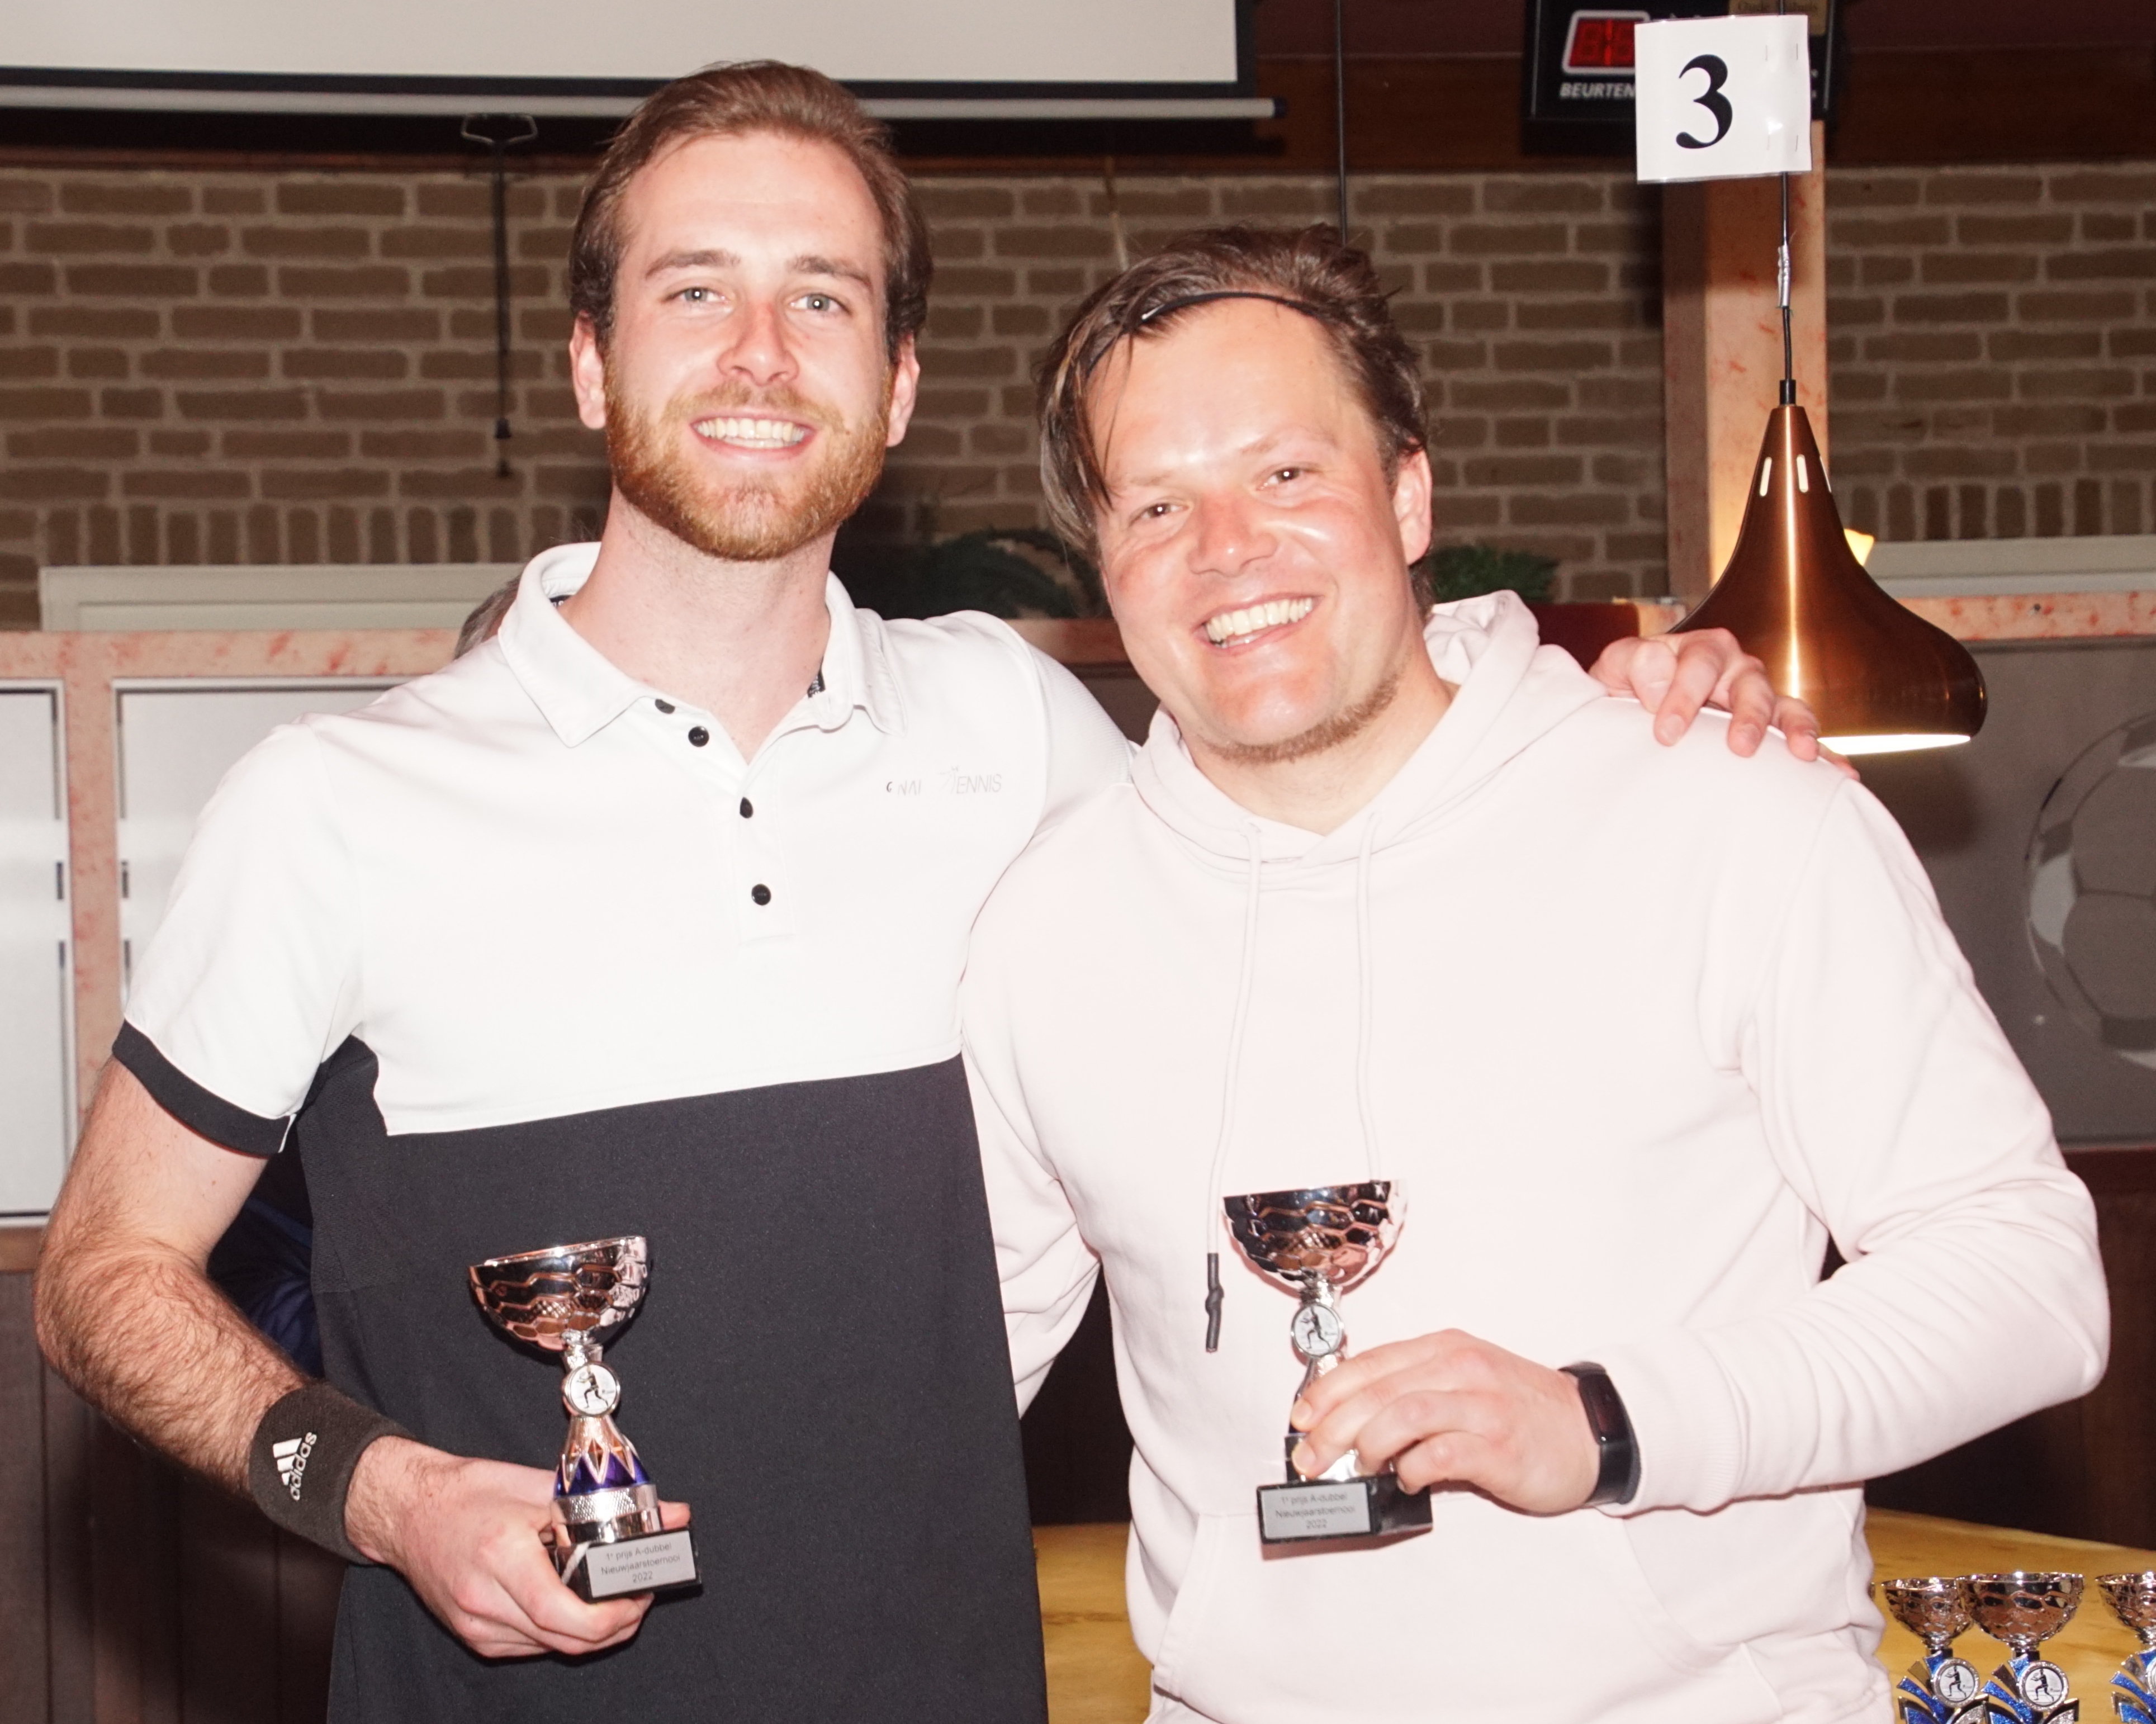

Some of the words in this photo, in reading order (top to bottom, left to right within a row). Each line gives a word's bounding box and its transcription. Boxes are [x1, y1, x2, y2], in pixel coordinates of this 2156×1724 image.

[1560, 82, 1636, 98] BEURTEN
[1676, 54, 1733, 149] 3
[290, 1432, 317, 1501] adidas
[616, 1550, 633, 1561] prijs
[635, 1542, 672, 1556] A-dubbel
[601, 1553, 681, 1575] Nieuwjaarstoernooi
[632, 1570, 653, 1583] 2022
